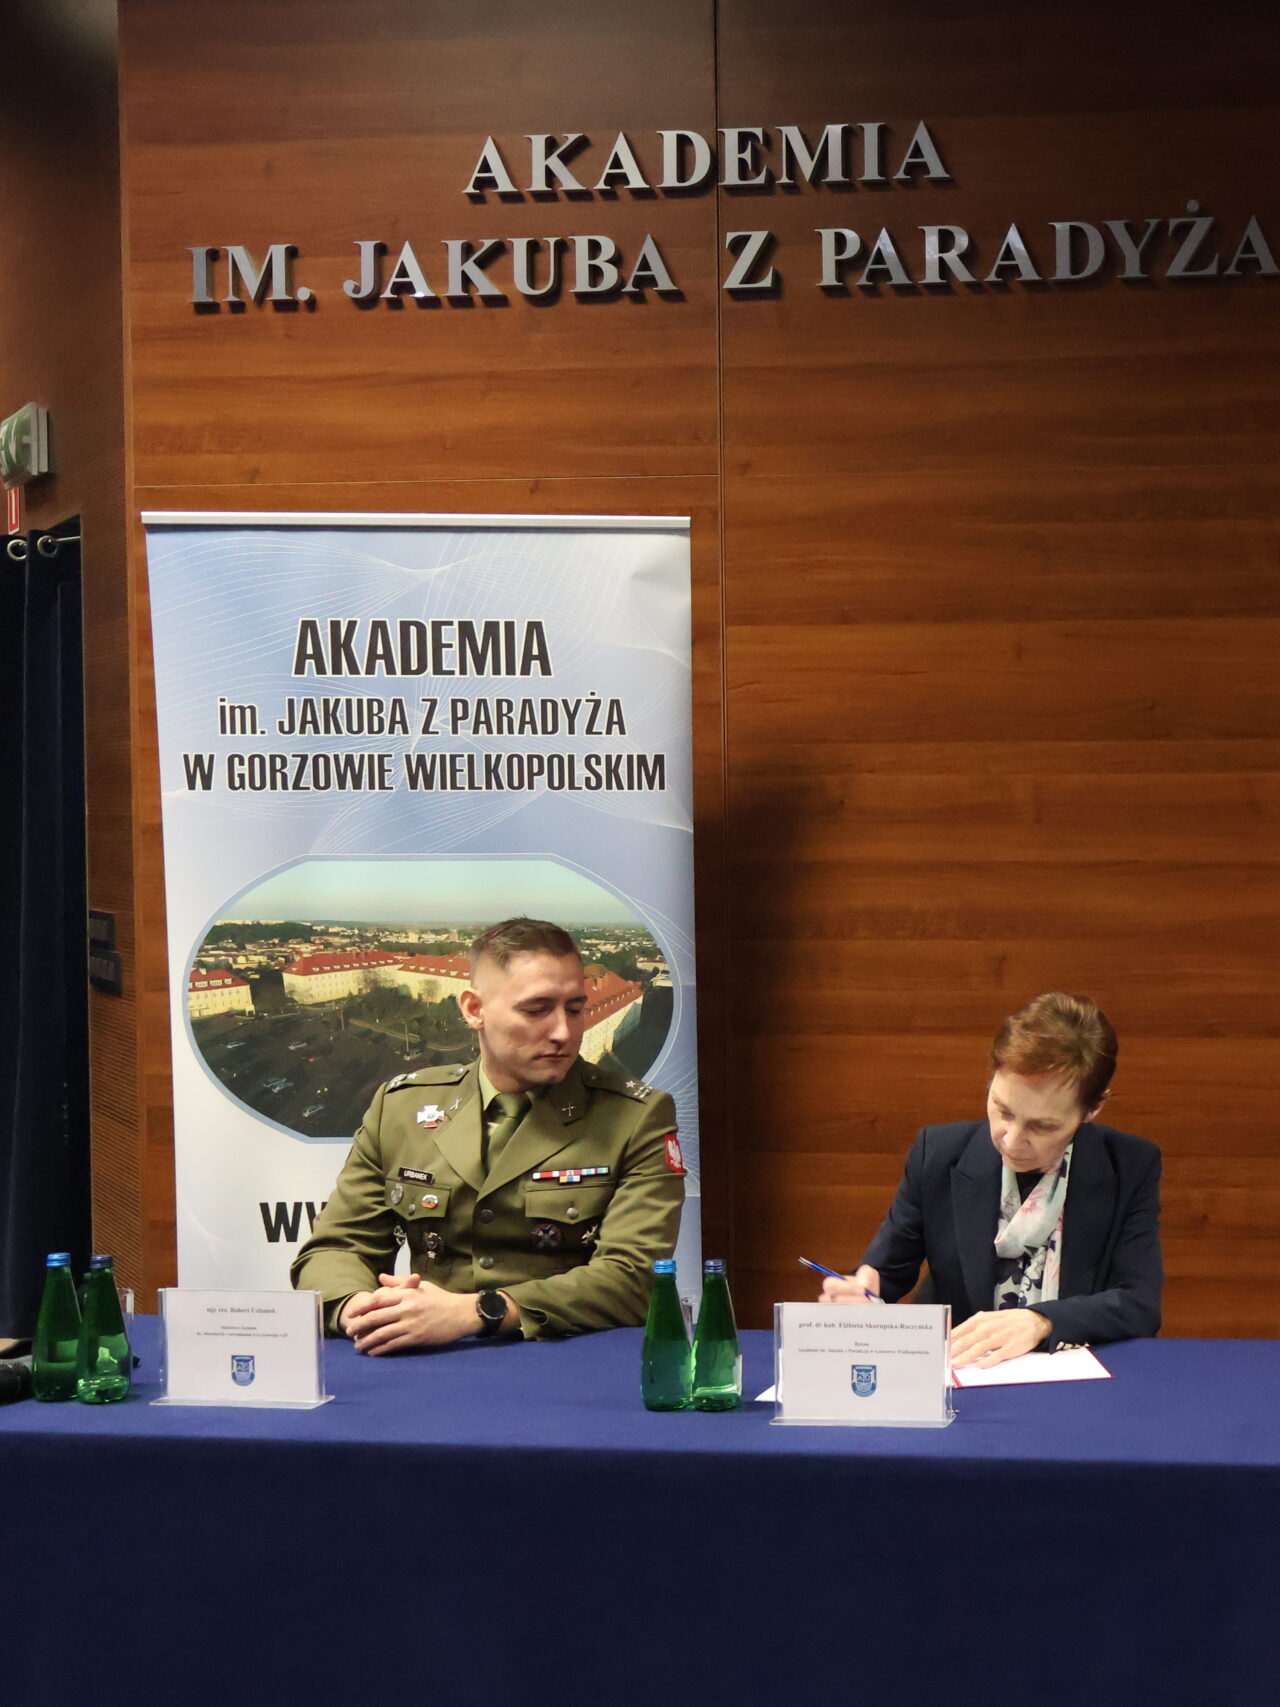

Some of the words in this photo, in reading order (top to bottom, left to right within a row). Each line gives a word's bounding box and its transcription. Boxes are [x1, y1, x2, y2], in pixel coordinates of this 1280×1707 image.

[462, 119, 951, 196] AKADEMIA
[186, 243, 316, 305] IM.
[343, 233, 679, 301] JAKUBA
[723, 229, 777, 291] Z
[293, 618, 553, 677] AKADEMIA
[218, 698, 267, 735] im.
[278, 698, 409, 735] JAKUBA
[421, 698, 440, 735] Z
[451, 692, 627, 735] PARADYŻA
[183, 754, 215, 791] W
[228, 754, 394, 791] GORZOWIE
[405, 754, 667, 791] WIELKOPOLSKIM
